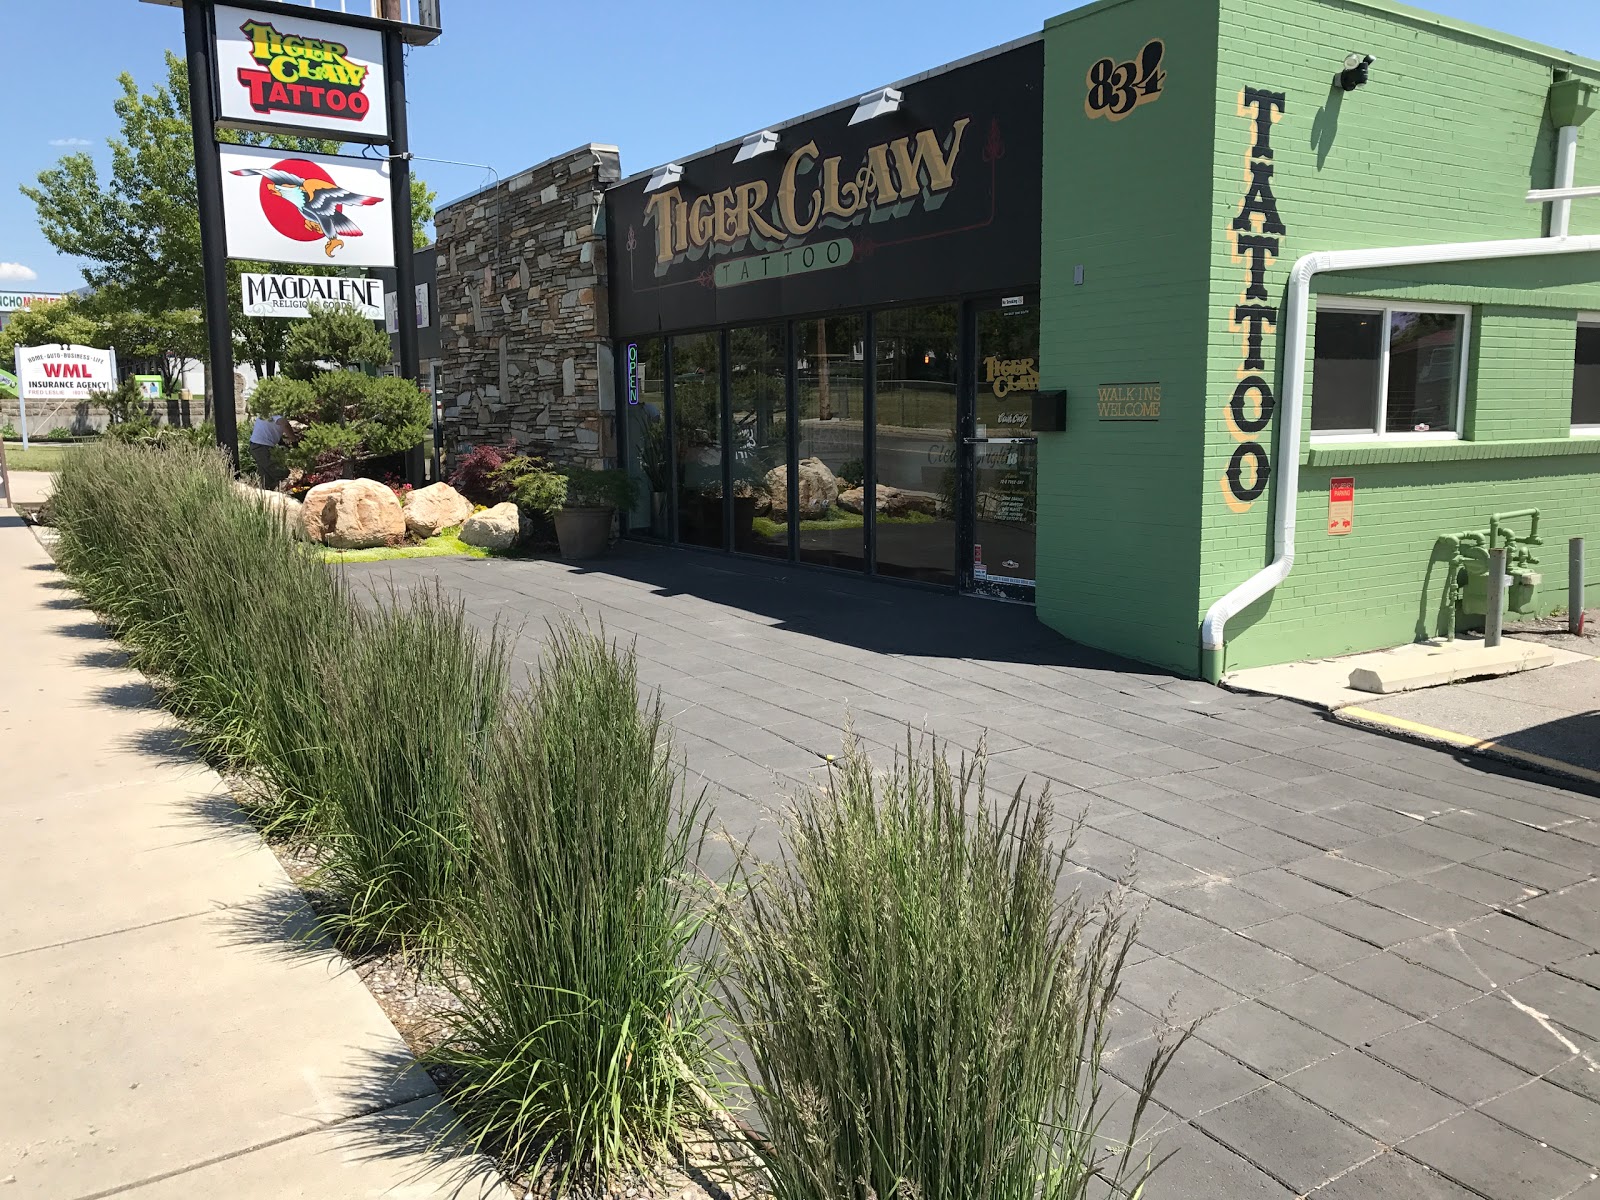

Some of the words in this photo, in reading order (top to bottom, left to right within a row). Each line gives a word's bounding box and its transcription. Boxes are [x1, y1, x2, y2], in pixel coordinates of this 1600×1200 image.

[243, 22, 347, 63] TIGER
[268, 55, 366, 87] CLAW
[1088, 41, 1166, 115] 834
[240, 70, 369, 114] TATTOO
[645, 180, 788, 263] TIGER
[777, 117, 971, 236] CLAW
[722, 241, 842, 284] TATTOO
[247, 276, 380, 309] MAGDALENE
[272, 299, 319, 309] RELIGIOS
[1225, 84, 1287, 501] TATTOO
[27, 355, 44, 363] HOME
[63, 352, 90, 360] BUSINESS
[92, 356, 104, 364] LIFE
[43, 363, 92, 378] WML
[629, 347, 637, 401] OPEN
[982, 355, 1037, 383] TIGER
[28, 380, 74, 389] INSURANCE
[76, 381, 107, 389] AGENCY
[1097, 402, 1160, 417] WELCOME
[1334, 489, 1351, 497] PARKING
